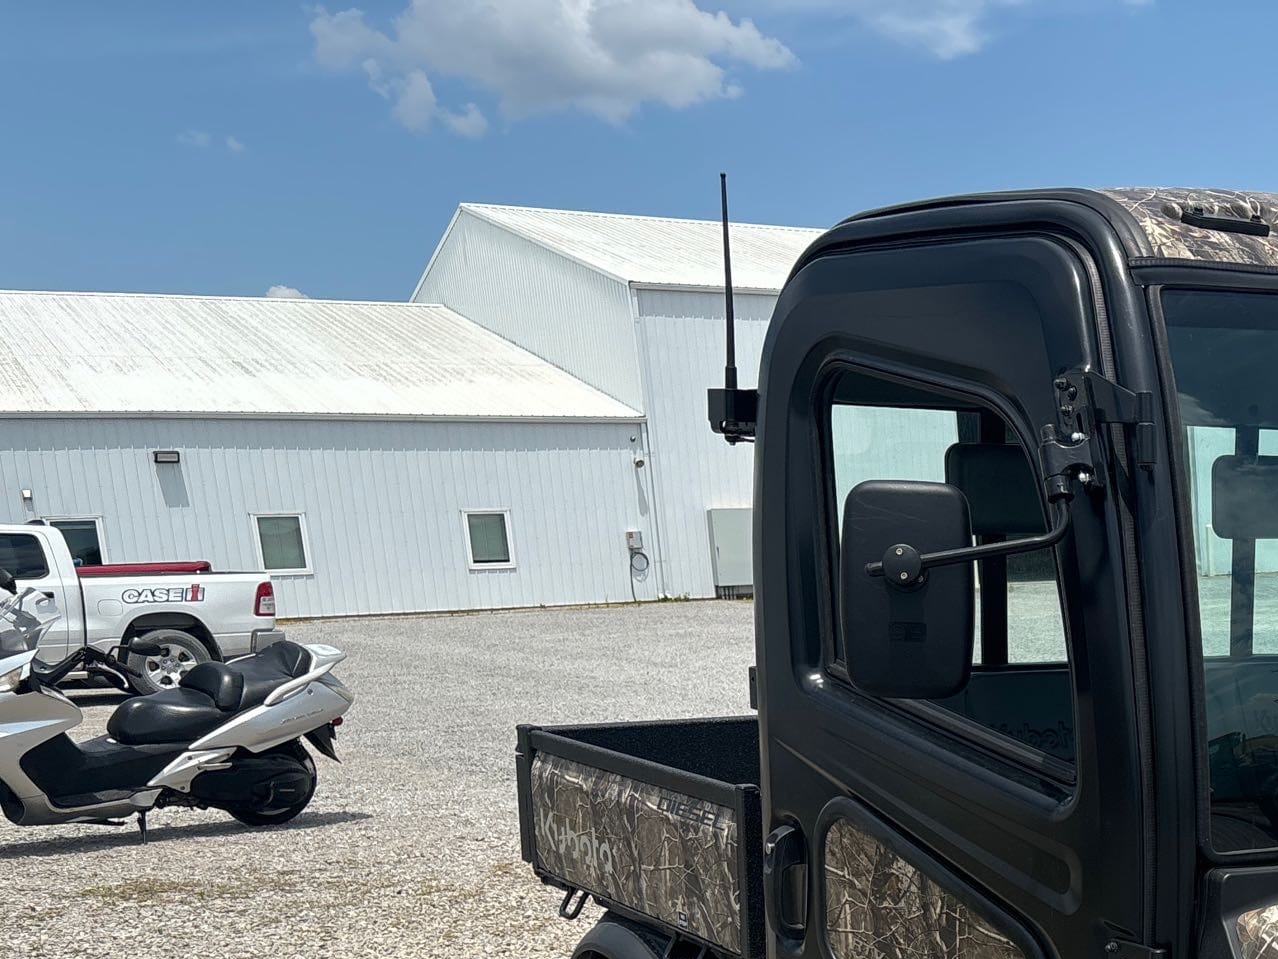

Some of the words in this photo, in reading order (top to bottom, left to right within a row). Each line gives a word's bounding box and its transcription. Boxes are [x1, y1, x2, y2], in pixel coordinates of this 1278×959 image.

[122, 588, 184, 604] CASE
[657, 796, 725, 831] DIESEL
[535, 807, 613, 874] Kubota
